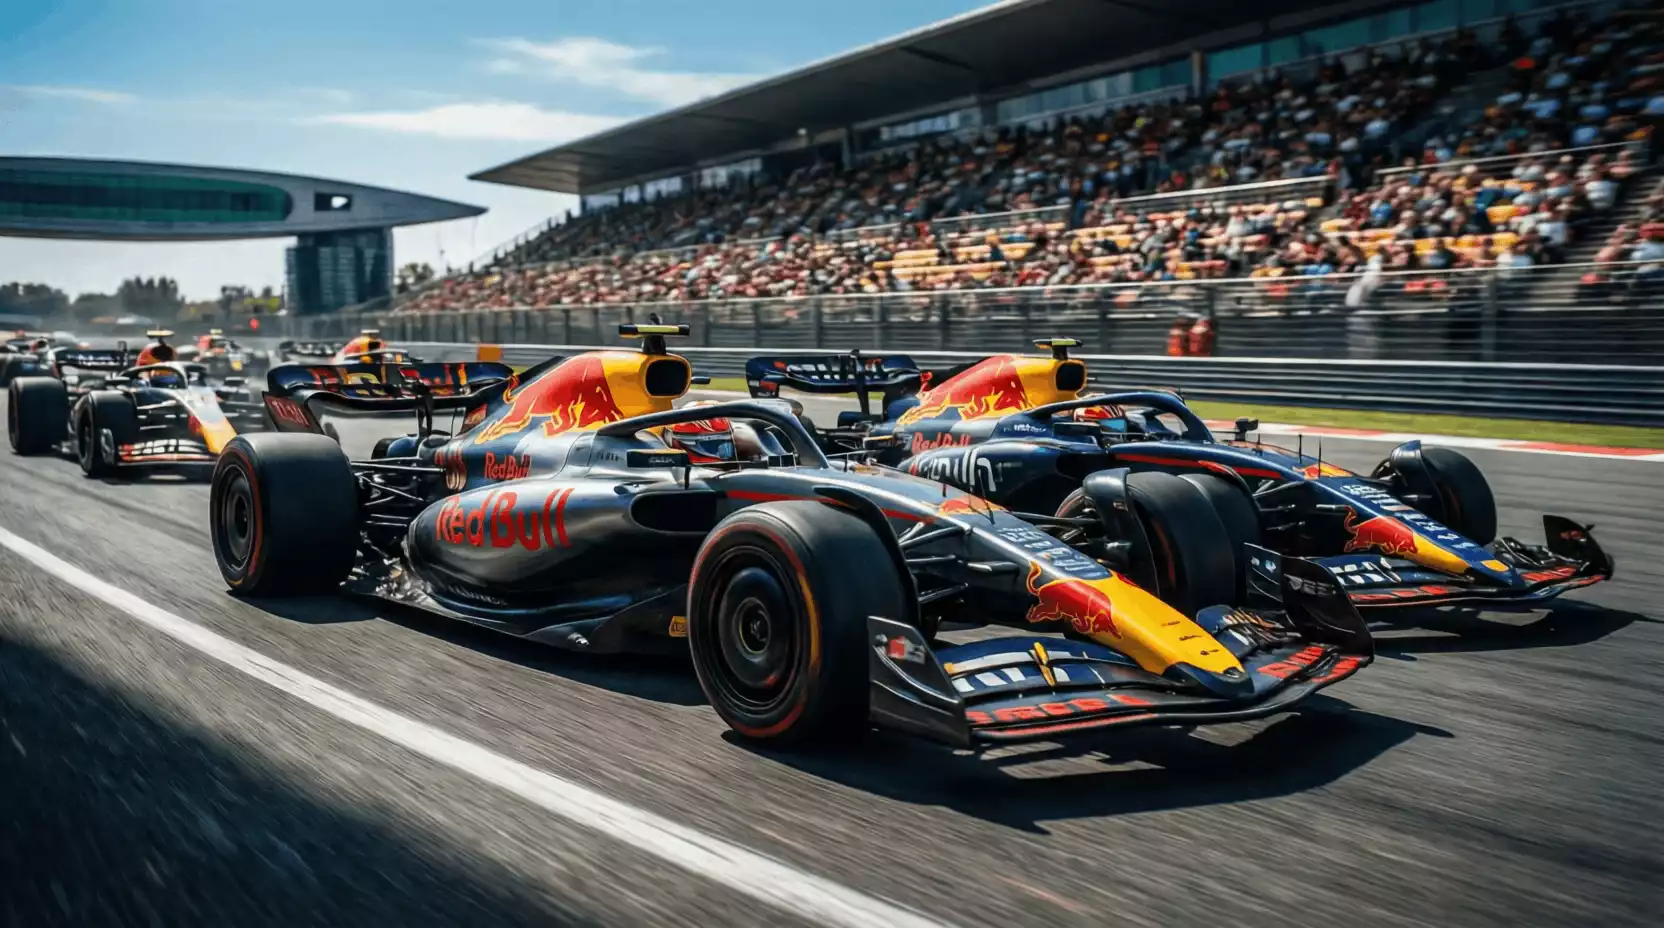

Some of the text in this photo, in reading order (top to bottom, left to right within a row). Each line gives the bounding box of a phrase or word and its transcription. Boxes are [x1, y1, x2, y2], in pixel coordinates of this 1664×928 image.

[485, 452, 506, 479] Red
[506, 454, 531, 479] Bull
[436, 488, 576, 550] Red Bull
